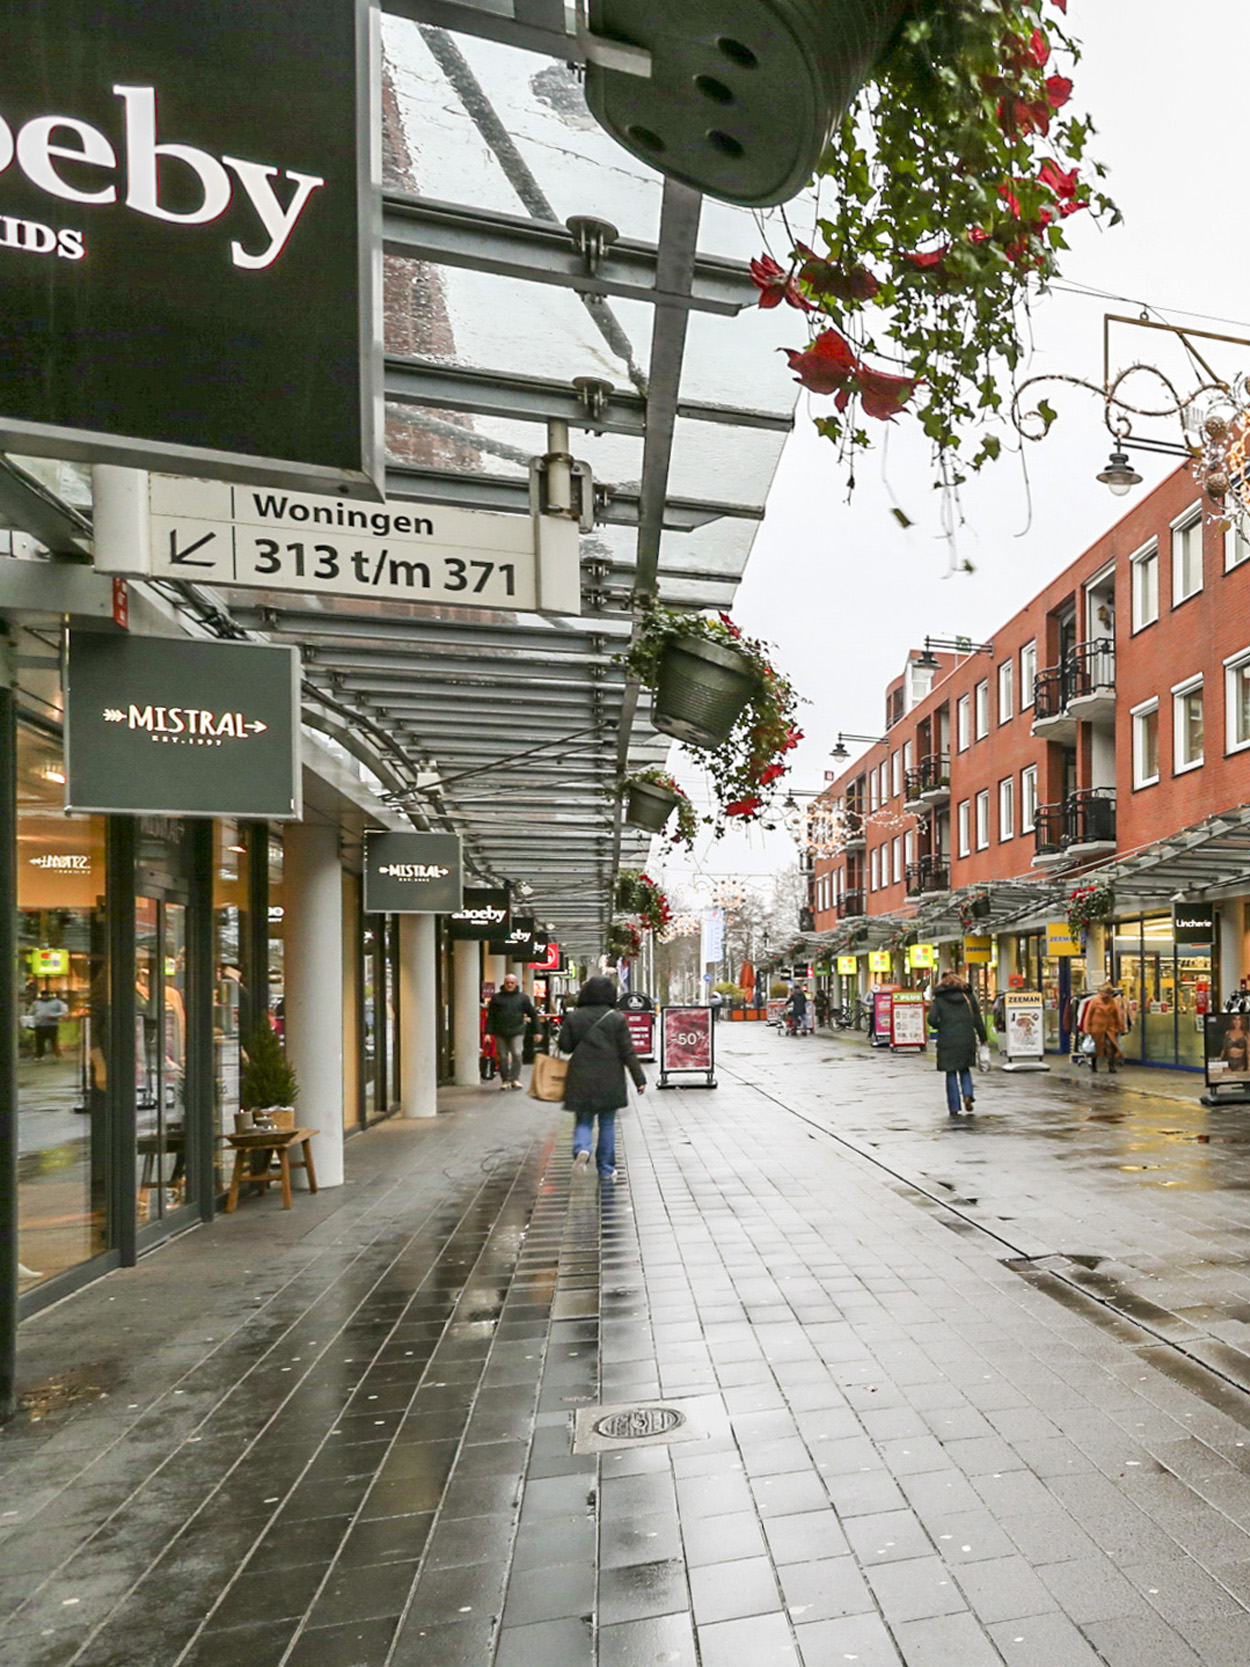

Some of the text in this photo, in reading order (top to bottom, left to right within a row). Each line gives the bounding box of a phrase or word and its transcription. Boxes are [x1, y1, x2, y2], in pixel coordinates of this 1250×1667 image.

[0, 84, 325, 269] eby
[0, 214, 86, 260] IDS
[253, 493, 434, 537] Woningen
[253, 538, 516, 597] 313 t/m 371
[128, 704, 249, 739] MISTRAL
[388, 864, 441, 878] MISTRAL
